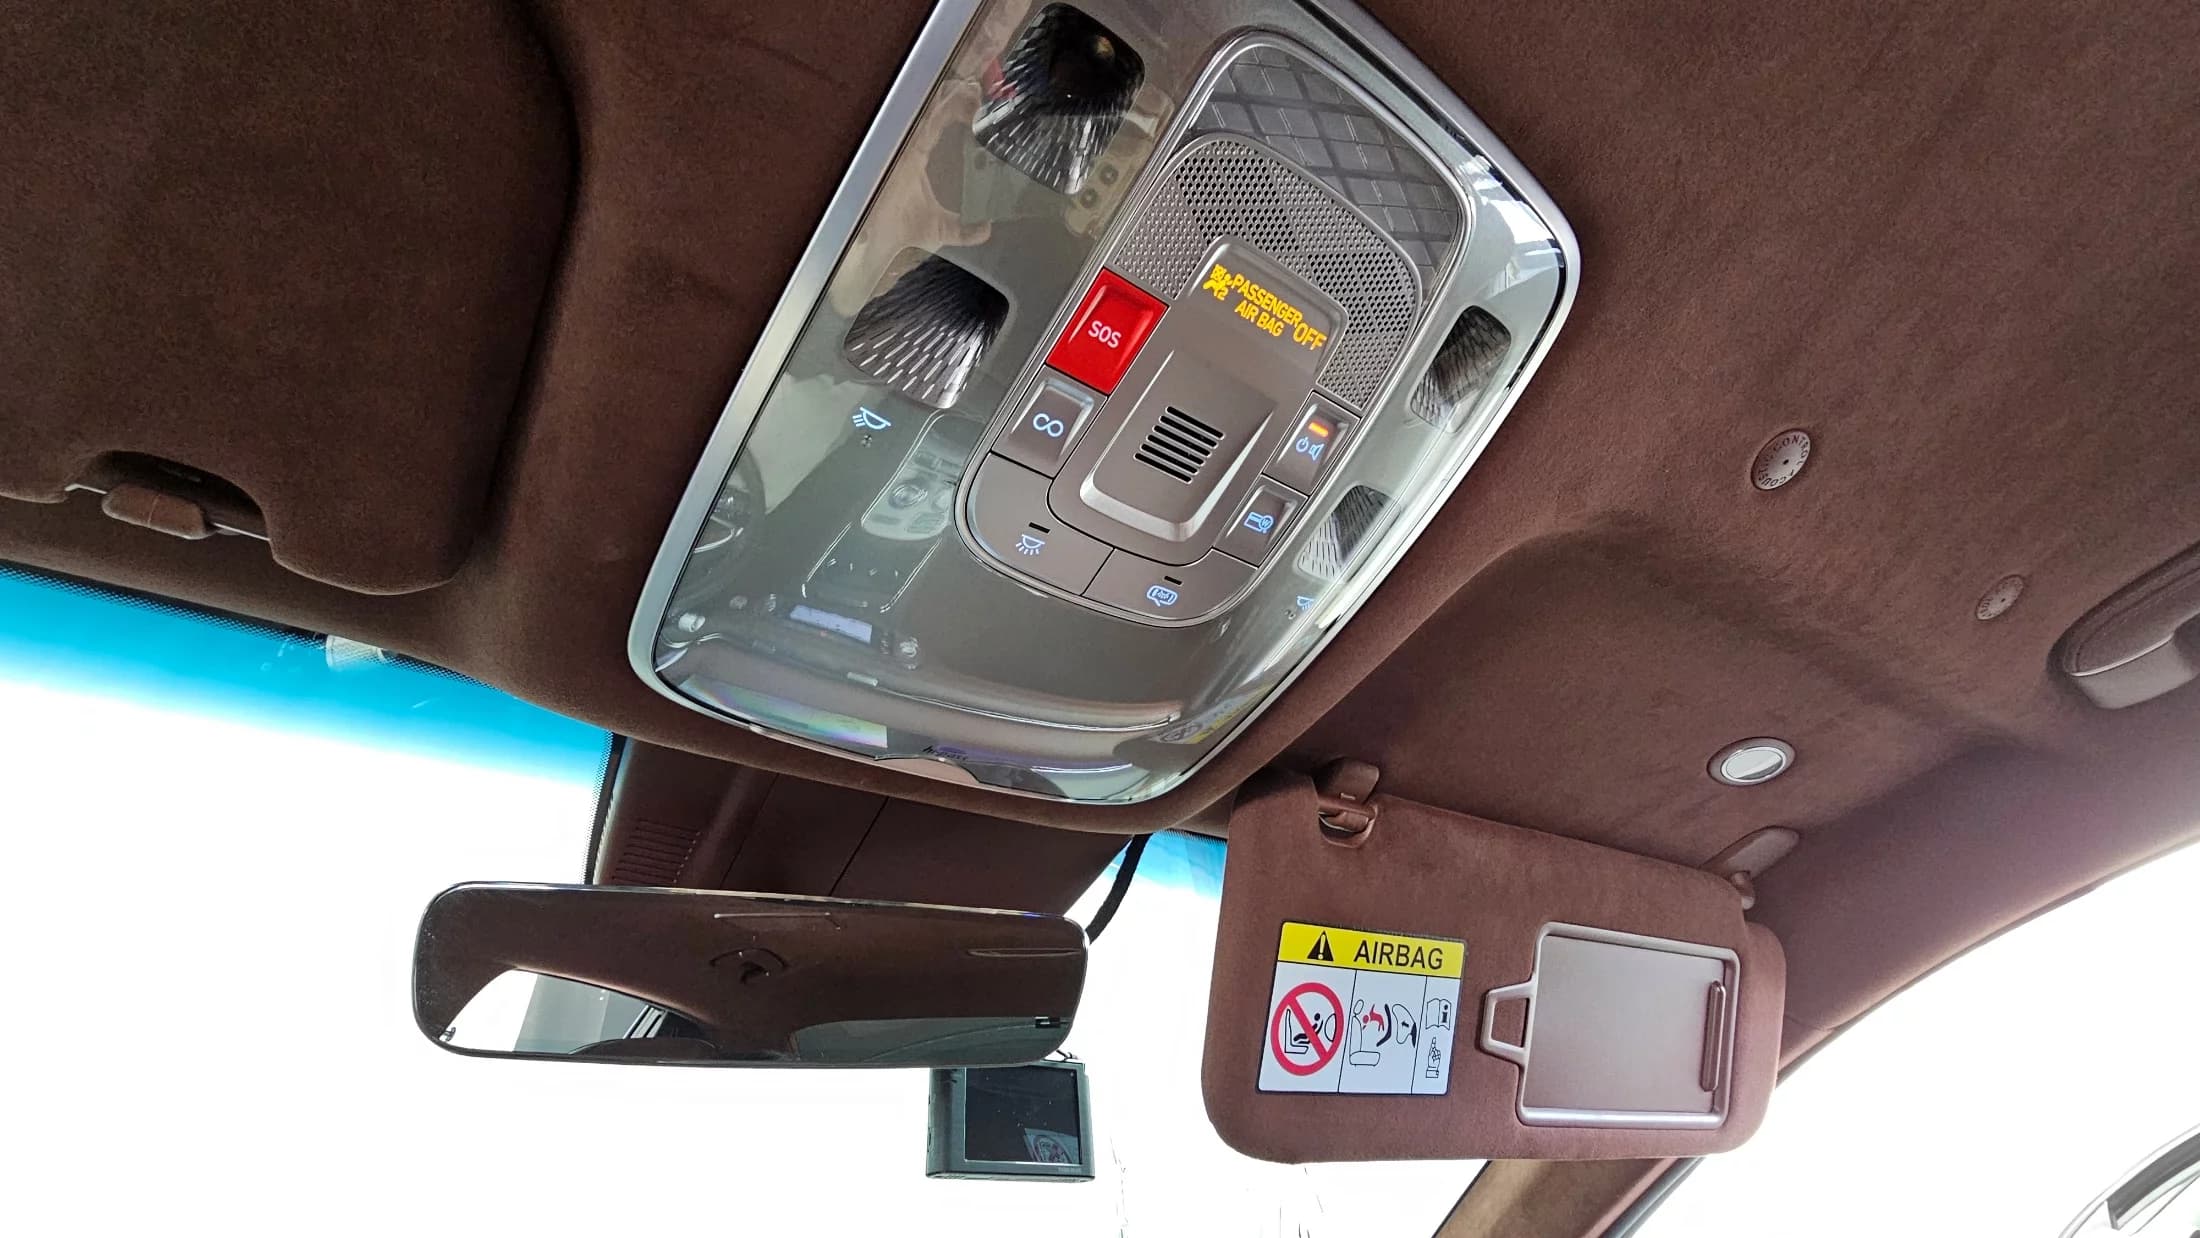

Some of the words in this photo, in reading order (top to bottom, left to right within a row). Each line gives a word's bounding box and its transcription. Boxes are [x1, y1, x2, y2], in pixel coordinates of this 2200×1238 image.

[1231, 273, 1303, 328] PASSENGER
[1087, 320, 1122, 348] SOS
[1234, 300, 1259, 322] AIR
[1256, 311, 1285, 337] BAG
[1293, 322, 1328, 350] OFF
[1353, 939, 1444, 970] AIRBAG
